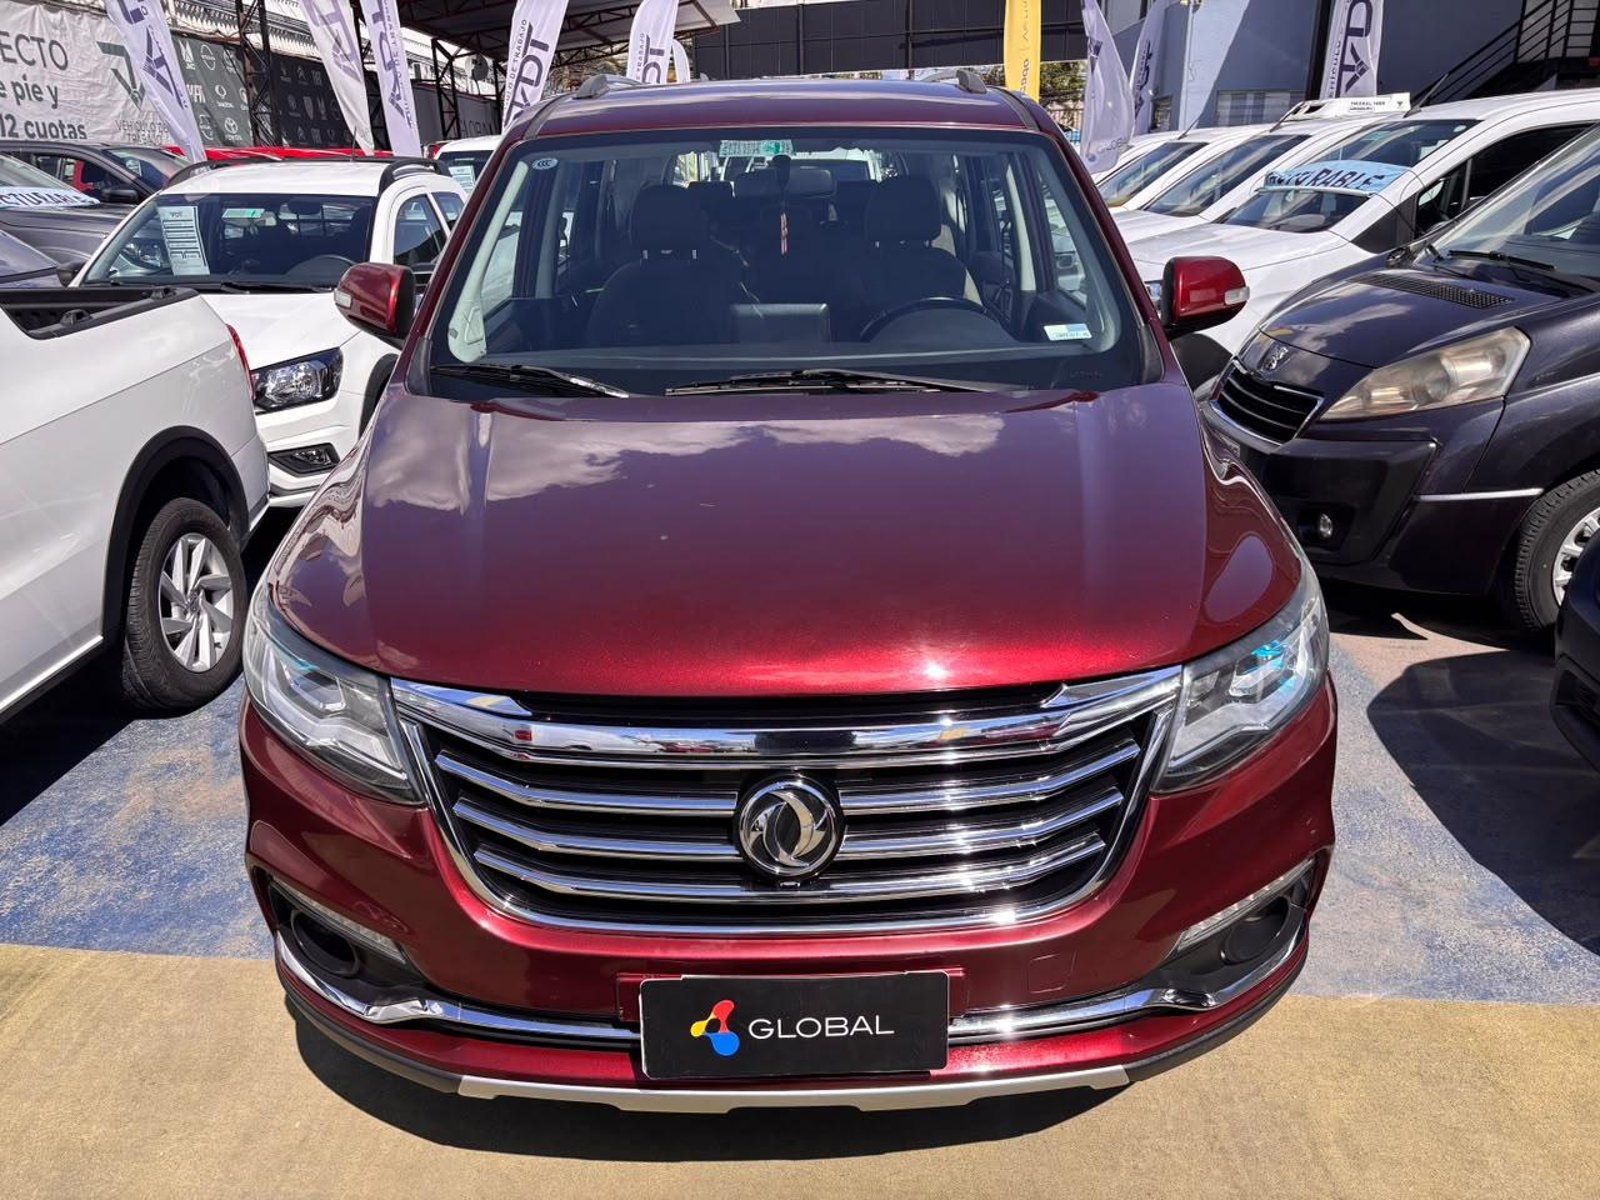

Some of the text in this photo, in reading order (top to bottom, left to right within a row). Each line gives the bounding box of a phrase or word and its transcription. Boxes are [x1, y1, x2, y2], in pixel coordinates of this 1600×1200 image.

[0, 31, 68, 71] ECTO
[11, 74, 43, 106] pie
[46, 85, 58, 109] y
[0, 113, 88, 140] 12 cuotas
[748, 1015, 895, 1040] GLOBAL
